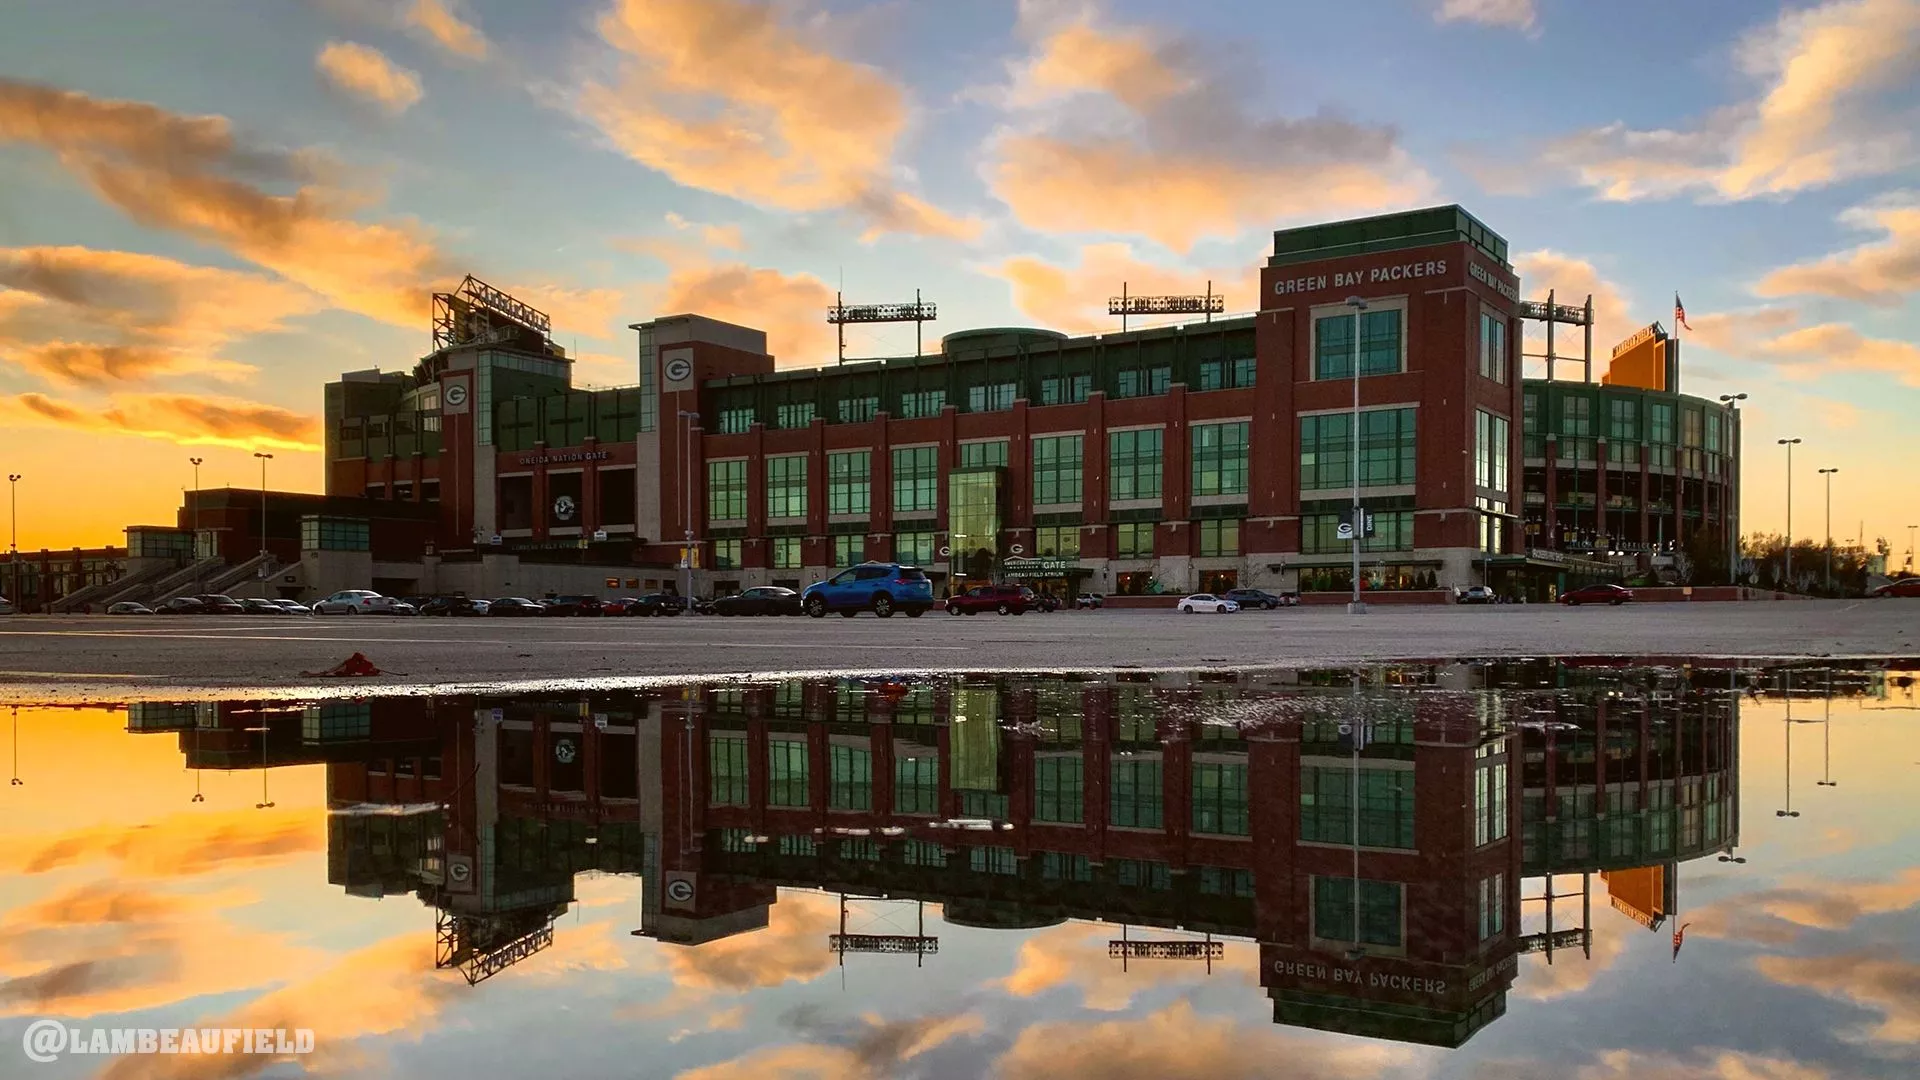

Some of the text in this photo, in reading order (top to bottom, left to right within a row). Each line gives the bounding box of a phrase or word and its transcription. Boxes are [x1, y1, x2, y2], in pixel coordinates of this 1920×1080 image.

[1274, 260, 1447, 295] GREEN BAY PACKERS
[1469, 261, 1487, 283] GREEN
[520, 451, 608, 465] ONEIDA NATION GATE
[1043, 561, 1066, 569] GATE
